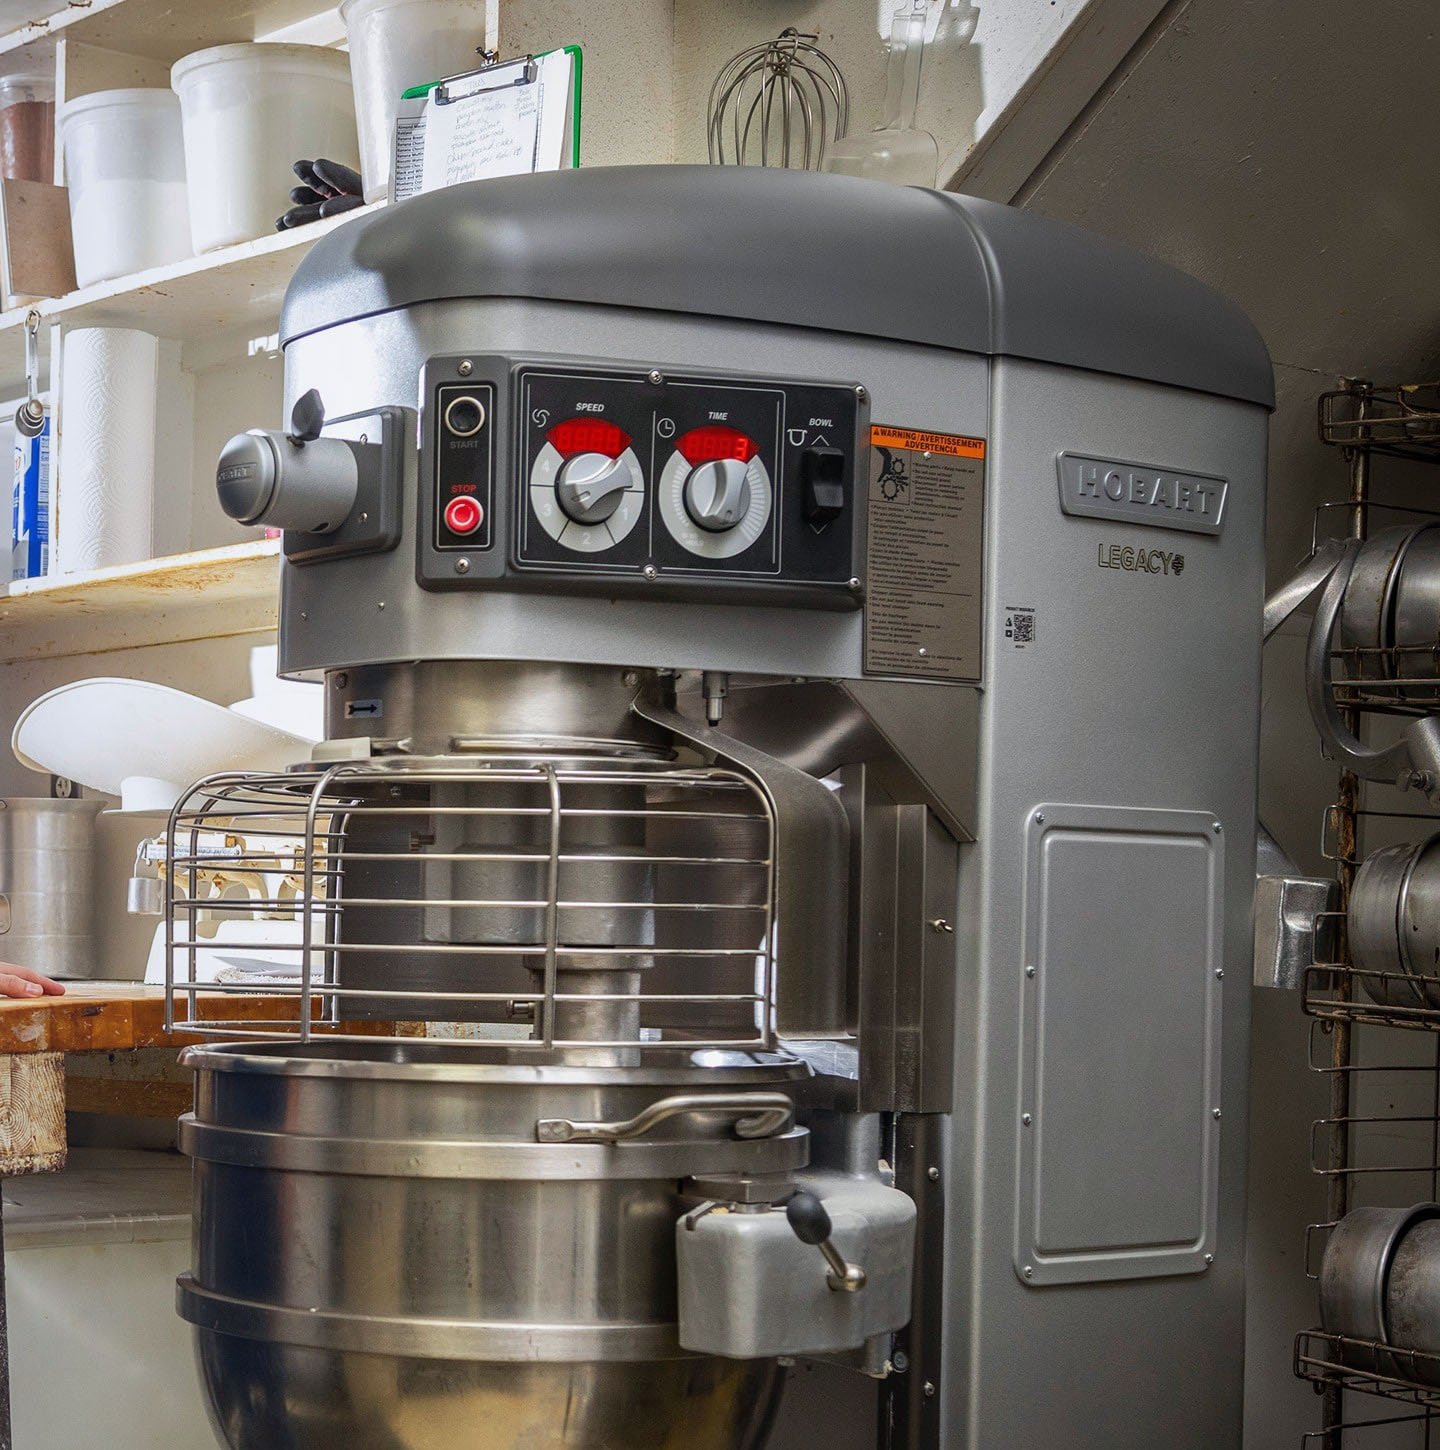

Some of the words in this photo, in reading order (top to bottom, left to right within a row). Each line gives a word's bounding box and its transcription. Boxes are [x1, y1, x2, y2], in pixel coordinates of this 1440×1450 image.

[575, 402, 605, 413] SPEED
[708, 411, 729, 421] TIME
[809, 417, 834, 427] BOWL
[450, 440, 479, 449] START
[904, 440, 958, 454] ADVERTENCIA
[541, 462, 551, 473] 4
[451, 484, 477, 493] STOP
[1078, 465, 1216, 514] HOBART
[543, 504, 552, 517] 3
[582, 532, 591, 545] 2
